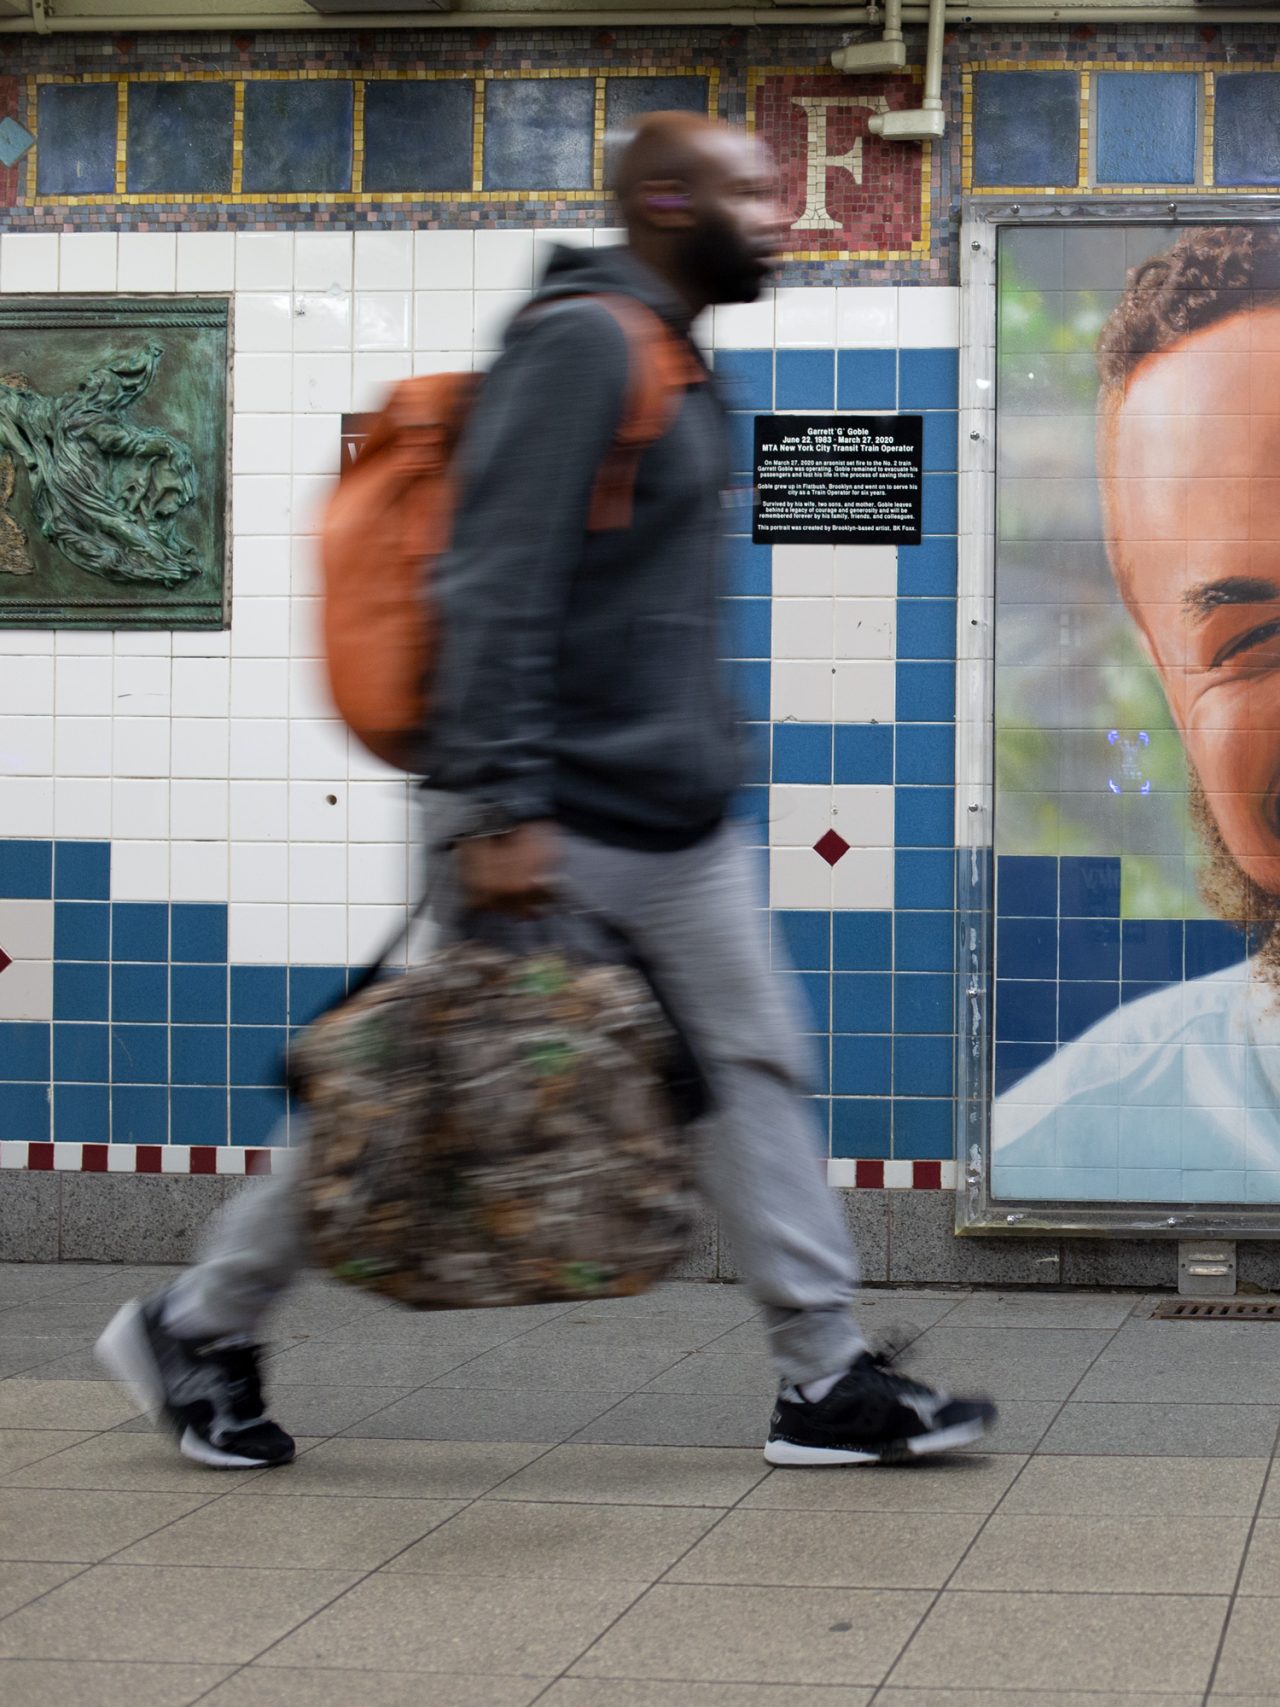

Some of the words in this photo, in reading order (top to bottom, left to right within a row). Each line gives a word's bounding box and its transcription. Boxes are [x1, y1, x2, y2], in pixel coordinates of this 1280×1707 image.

[790, 95, 891, 230] F
[807, 427, 834, 436] Garrett
[847, 428, 869, 436] Goble
[782, 436, 800, 444] June
[814, 436, 832, 444] 1983
[838, 436, 861, 444] March
[875, 436, 894, 444] 2020
[762, 444, 778, 452] MTA
[779, 444, 796, 452] New
[797, 444, 814, 452] York
[815, 444, 831, 453] City
[833, 444, 858, 452] Transit
[881, 445, 914, 453] Operator
[828, 483, 853, 491] Brooklyn
[849, 507, 878, 515] generosity
[770, 524, 790, 532] portrait
